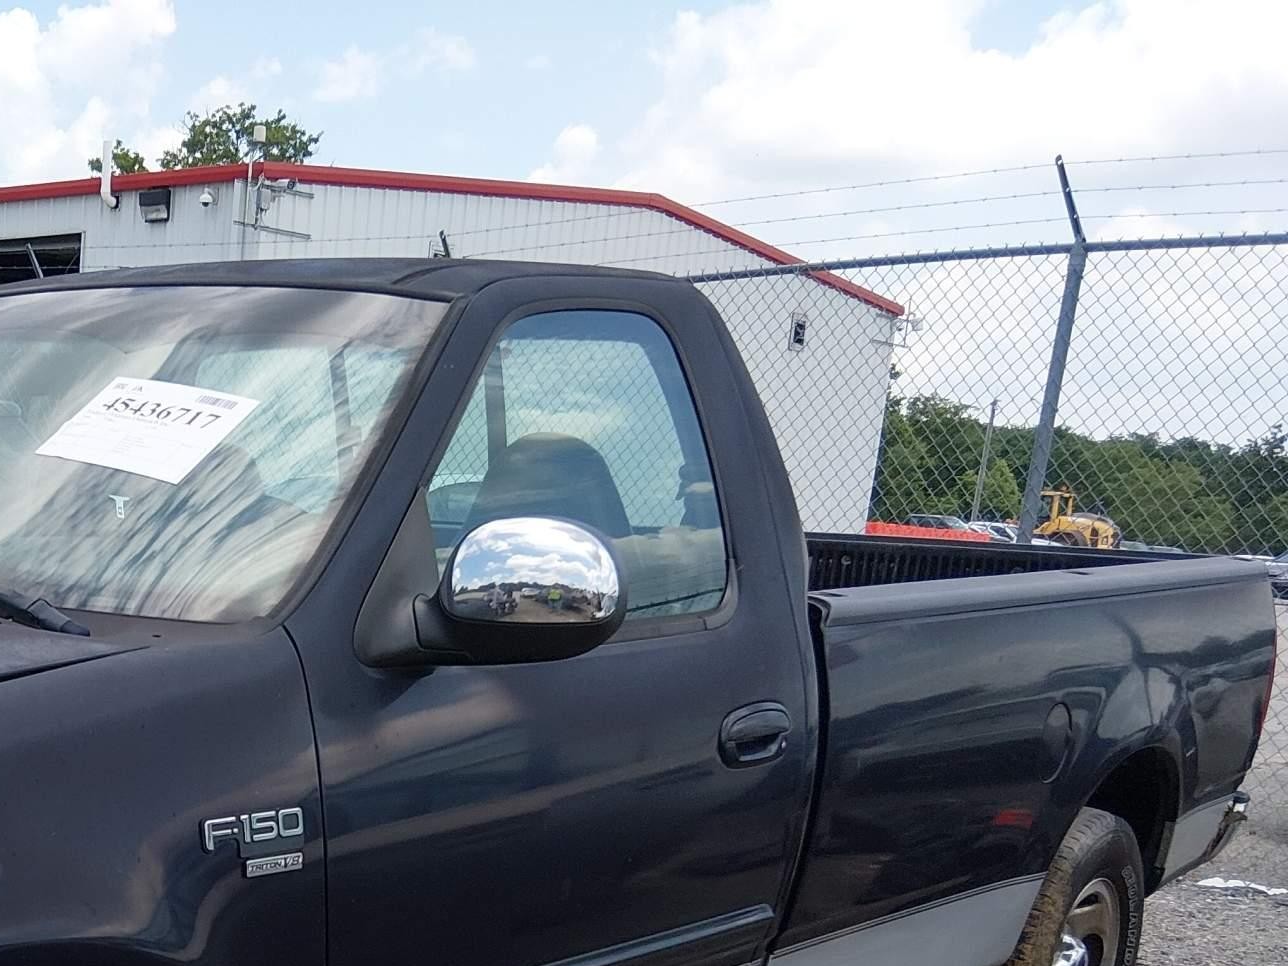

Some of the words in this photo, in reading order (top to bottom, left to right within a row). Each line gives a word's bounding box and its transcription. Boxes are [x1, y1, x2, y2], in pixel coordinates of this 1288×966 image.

[102, 396, 222, 429] 45436717
[249, 859, 283, 872] TRITON
[283, 854, 302, 869] V8
